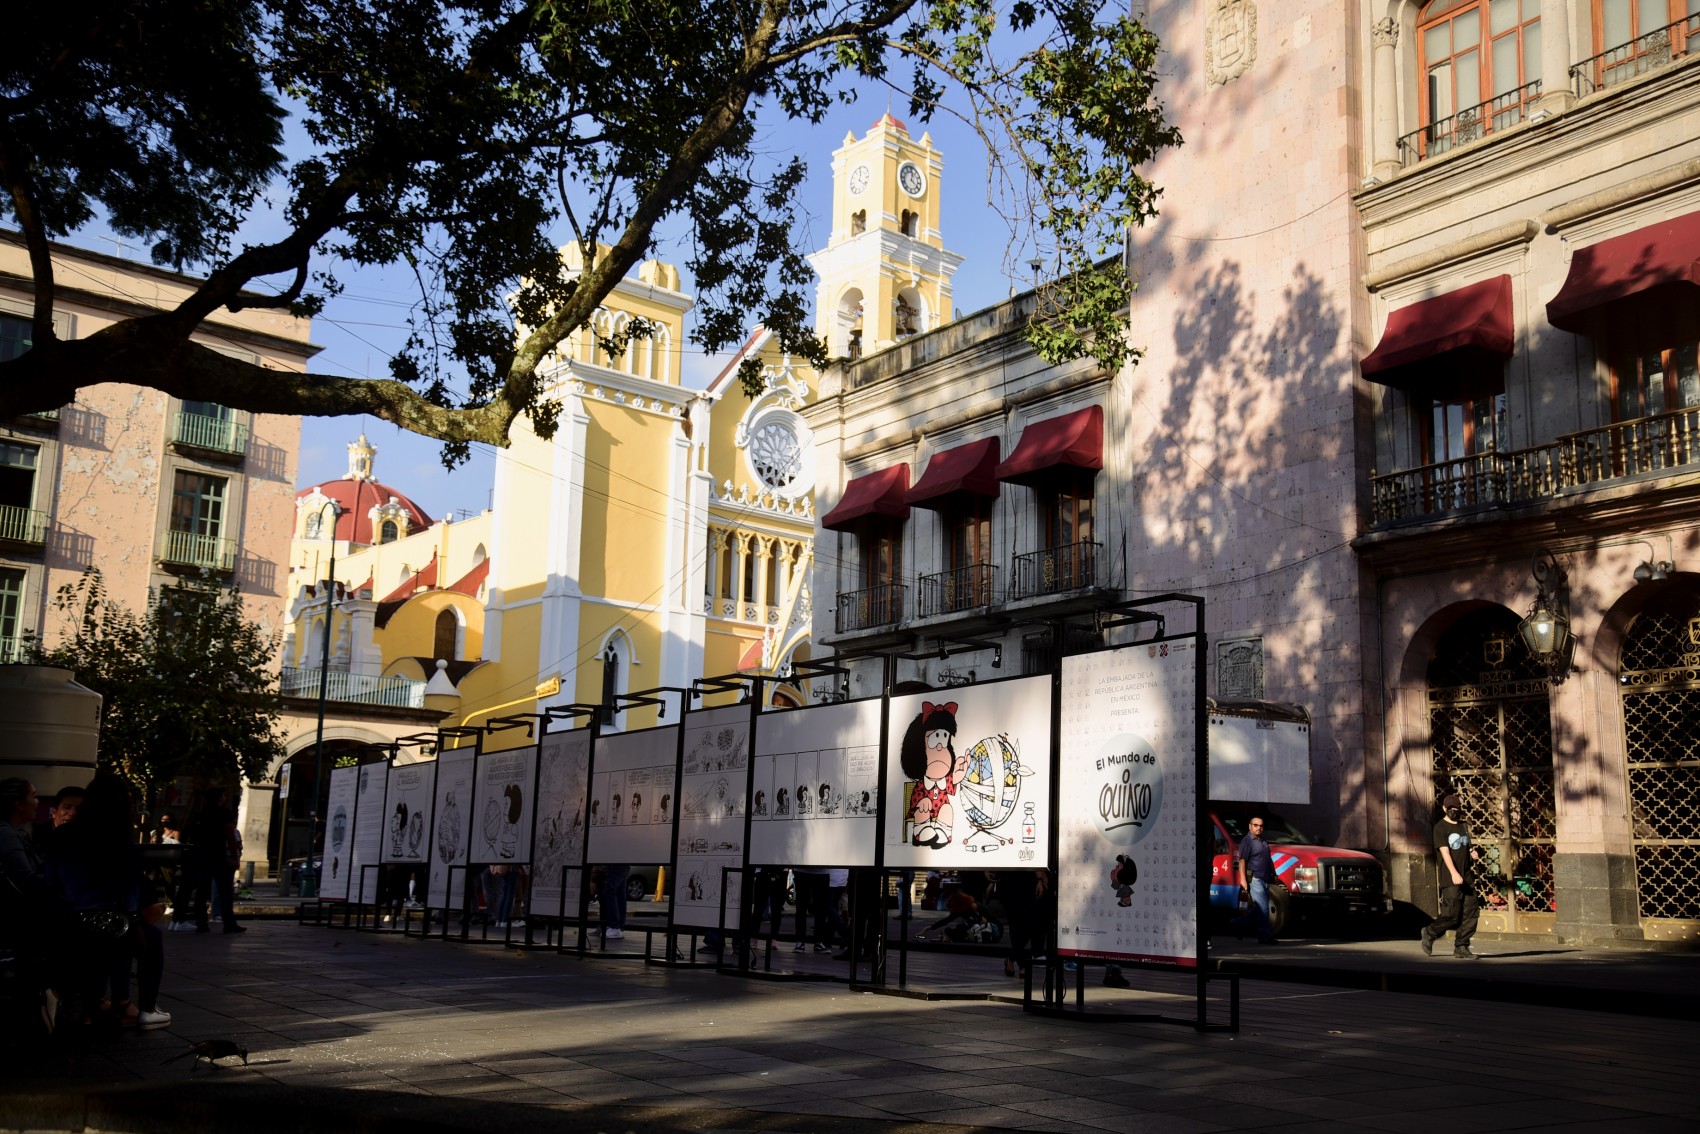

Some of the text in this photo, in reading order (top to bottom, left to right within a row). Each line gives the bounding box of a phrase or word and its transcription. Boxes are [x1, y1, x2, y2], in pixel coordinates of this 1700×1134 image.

[1106, 673, 1136, 684] EMBAJADA
[1137, 672, 1145, 680] DE
[1631, 669, 1697, 685] GOBIERNO
[1125, 681, 1158, 691] ARGENTINA
[1436, 680, 1550, 700] GOBIERNO DEL ESTAD
[1096, 751, 1156, 771] El Mundo de
[1221, 859, 1229, 872] 4
